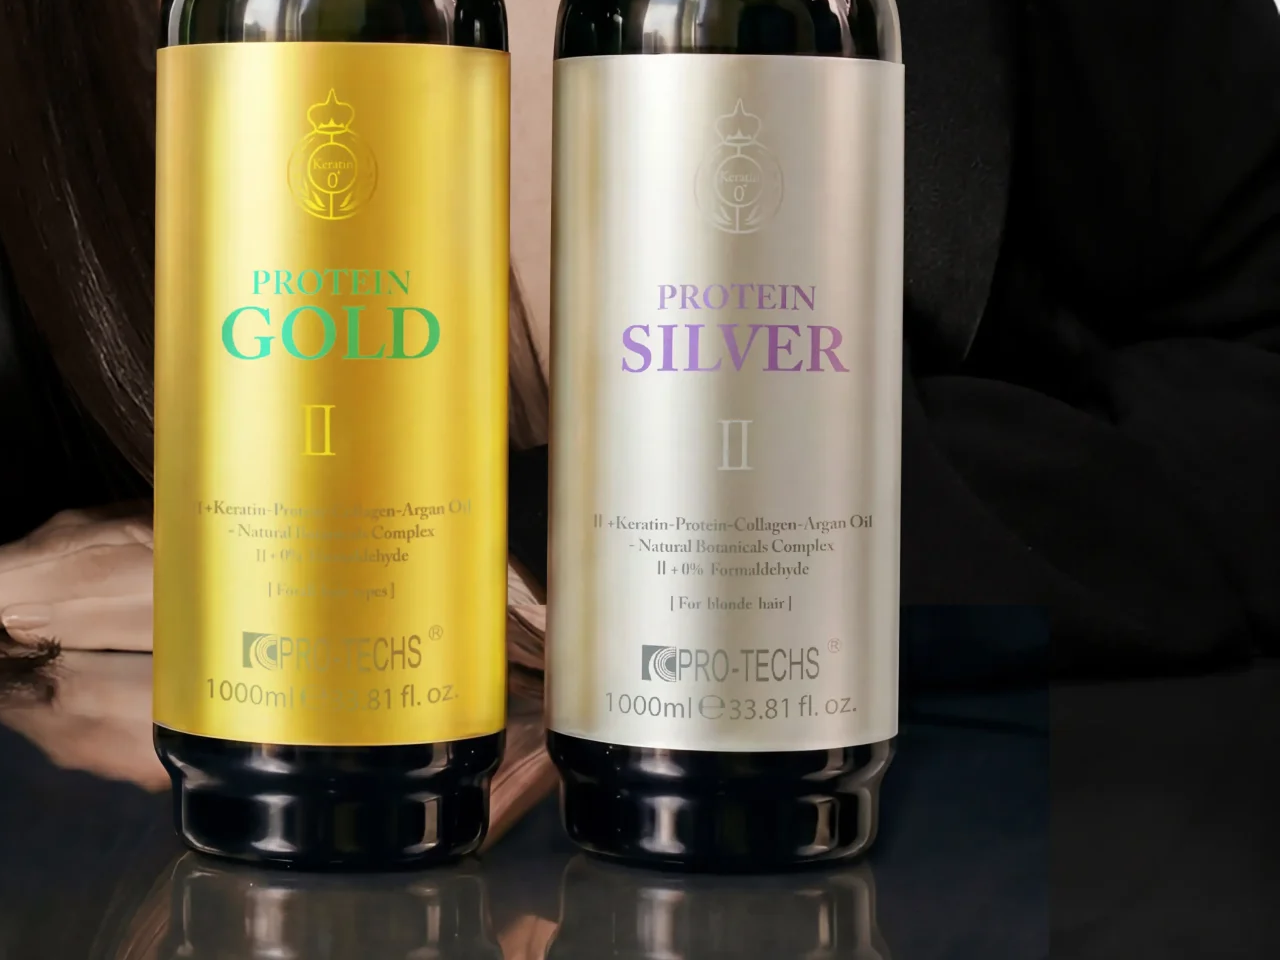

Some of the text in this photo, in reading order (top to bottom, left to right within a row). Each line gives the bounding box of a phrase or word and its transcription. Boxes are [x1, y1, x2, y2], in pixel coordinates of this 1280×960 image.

[313, 158, 353, 170] Keratin
[251, 268, 411, 295] PROTEIN
[657, 283, 816, 311] PROTEIN
[221, 305, 440, 360] GOLD
[621, 323, 850, 373] SILVER
[300, 404, 336, 455] II
[717, 420, 753, 470] II
[449, 498, 471, 514] Oil
[237, 524, 291, 539] Natural
[372, 524, 435, 543] Complex
[849, 514, 872, 529] Oil
[639, 538, 692, 552] Natural
[695, 539, 769, 554] Botanicals
[772, 538, 835, 557] Complex
[711, 561, 809, 580] Formaldehyde
[678, 595, 702, 609] For
[707, 596, 752, 610] blonde
[759, 596, 785, 610] hair
[280, 634, 422, 673] PRO-TECHS
[678, 647, 820, 683] PRO-TECHS
[207, 678, 294, 709] 1000ml
[400, 684, 421, 708] fl.
[428, 684, 459, 704] oz.
[606, 692, 692, 719] 1000ml
[729, 698, 790, 720] 33.81
[799, 695, 818, 717] fl.
[825, 697, 857, 715] oz.
